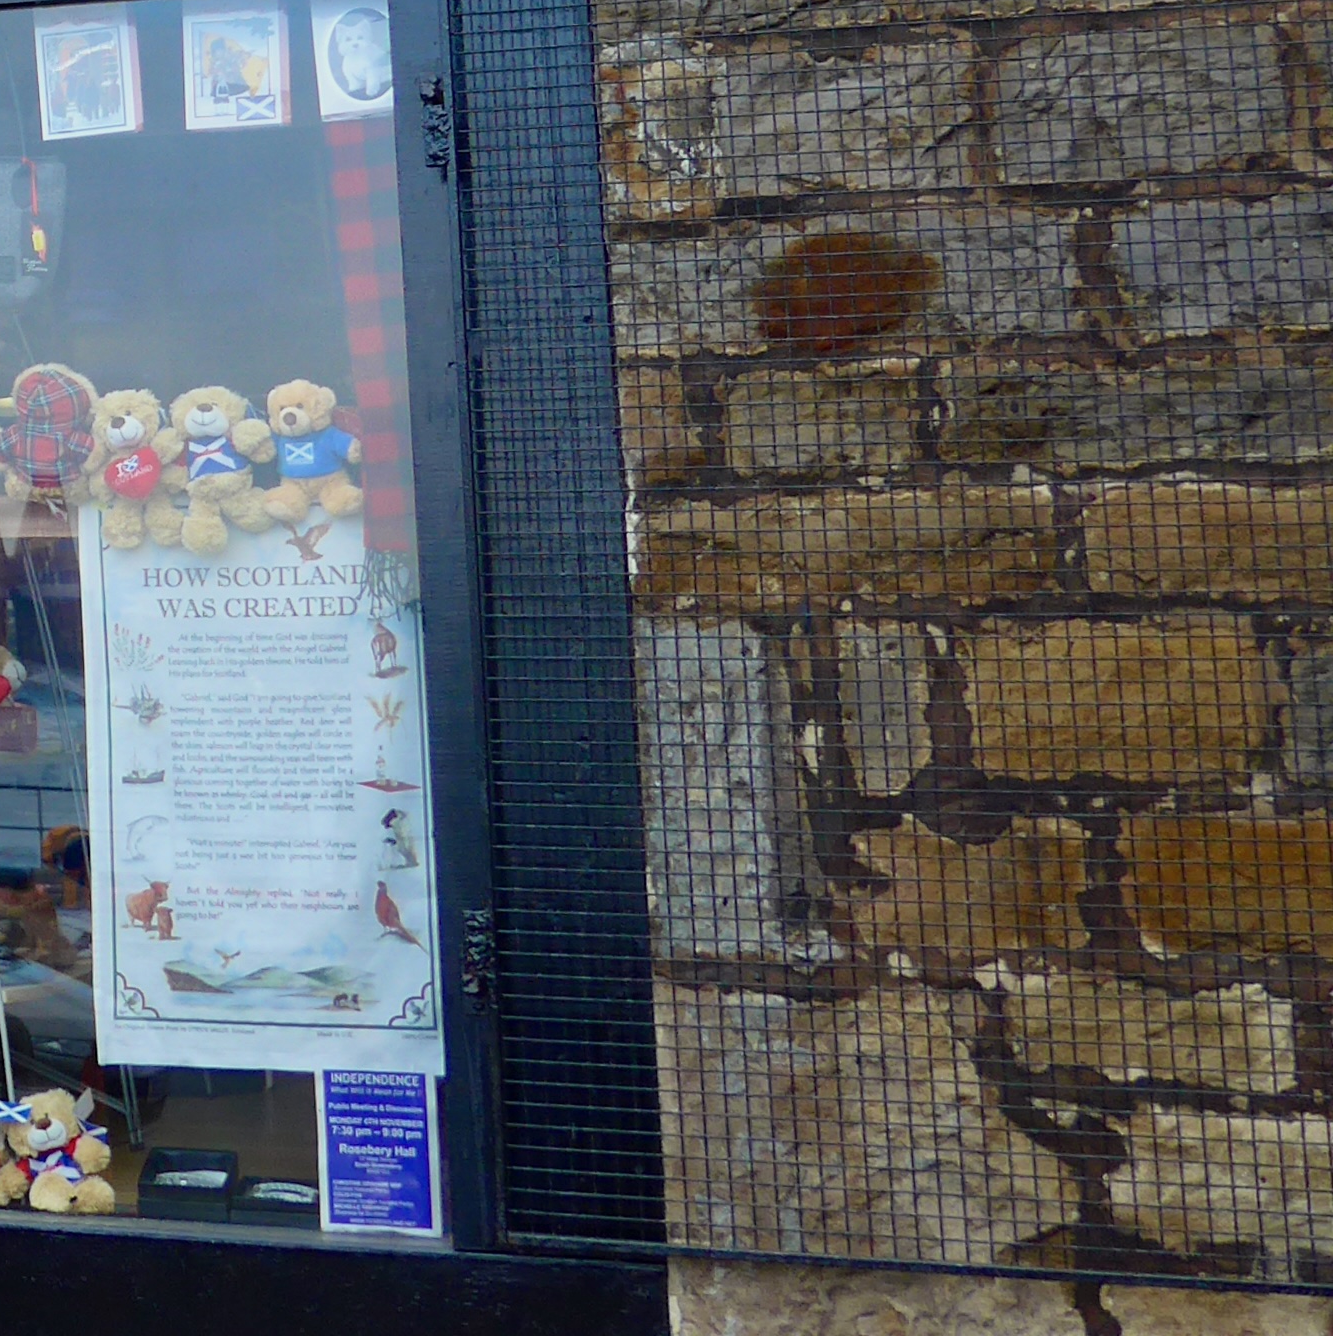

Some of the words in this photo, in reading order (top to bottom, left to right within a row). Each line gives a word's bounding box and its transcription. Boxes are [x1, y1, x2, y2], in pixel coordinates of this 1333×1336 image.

[142, 567, 210, 588] HOW
[217, 564, 368, 587] SCOTLAND
[156, 598, 216, 619] WAS
[224, 596, 358, 619] CREATED
[330, 1073, 420, 1087] INDEPENDENCE
[332, 1125, 354, 1136] 7:30
[339, 1143, 392, 1157] Rosebery
[394, 1146, 416, 1158] Hall
